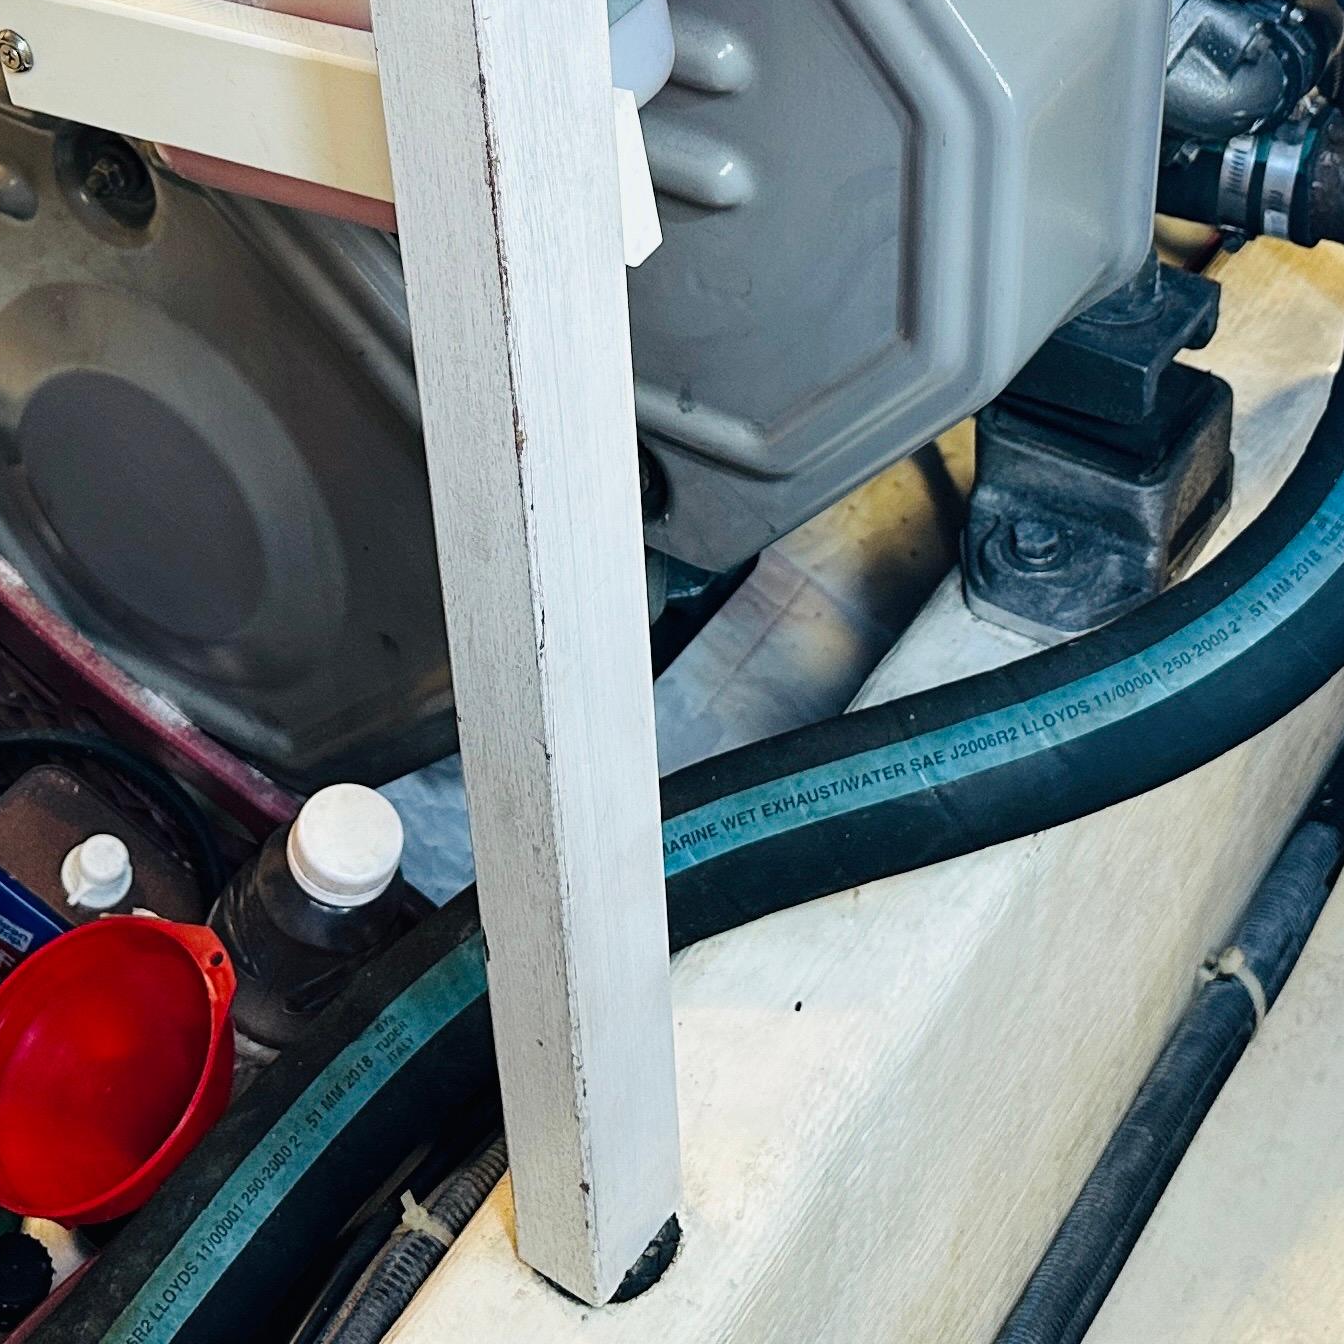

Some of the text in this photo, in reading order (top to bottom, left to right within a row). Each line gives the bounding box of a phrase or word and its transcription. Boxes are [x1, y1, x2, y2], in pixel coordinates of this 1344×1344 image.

[721, 808, 756, 832] WET
[761, 761, 907, 818] EXHAUST/WATER
[909, 749, 945, 773] SAE
[950, 726, 1018, 761] J2006R2
[1021, 700, 1091, 736] LLOYDS
[1093, 668, 1162, 709] 11/00001
[1162, 627, 1229, 675] 250-2000
[1290, 548, 1322, 582] 2018
[149, 1260, 199, 1322] LLOYDS
[195, 1203, 245, 1262] 11/00001
[241, 1144, 293, 1206] 250-2000
[320, 1083, 346, 1113] MM
[346, 1055, 374, 1090] 2018
